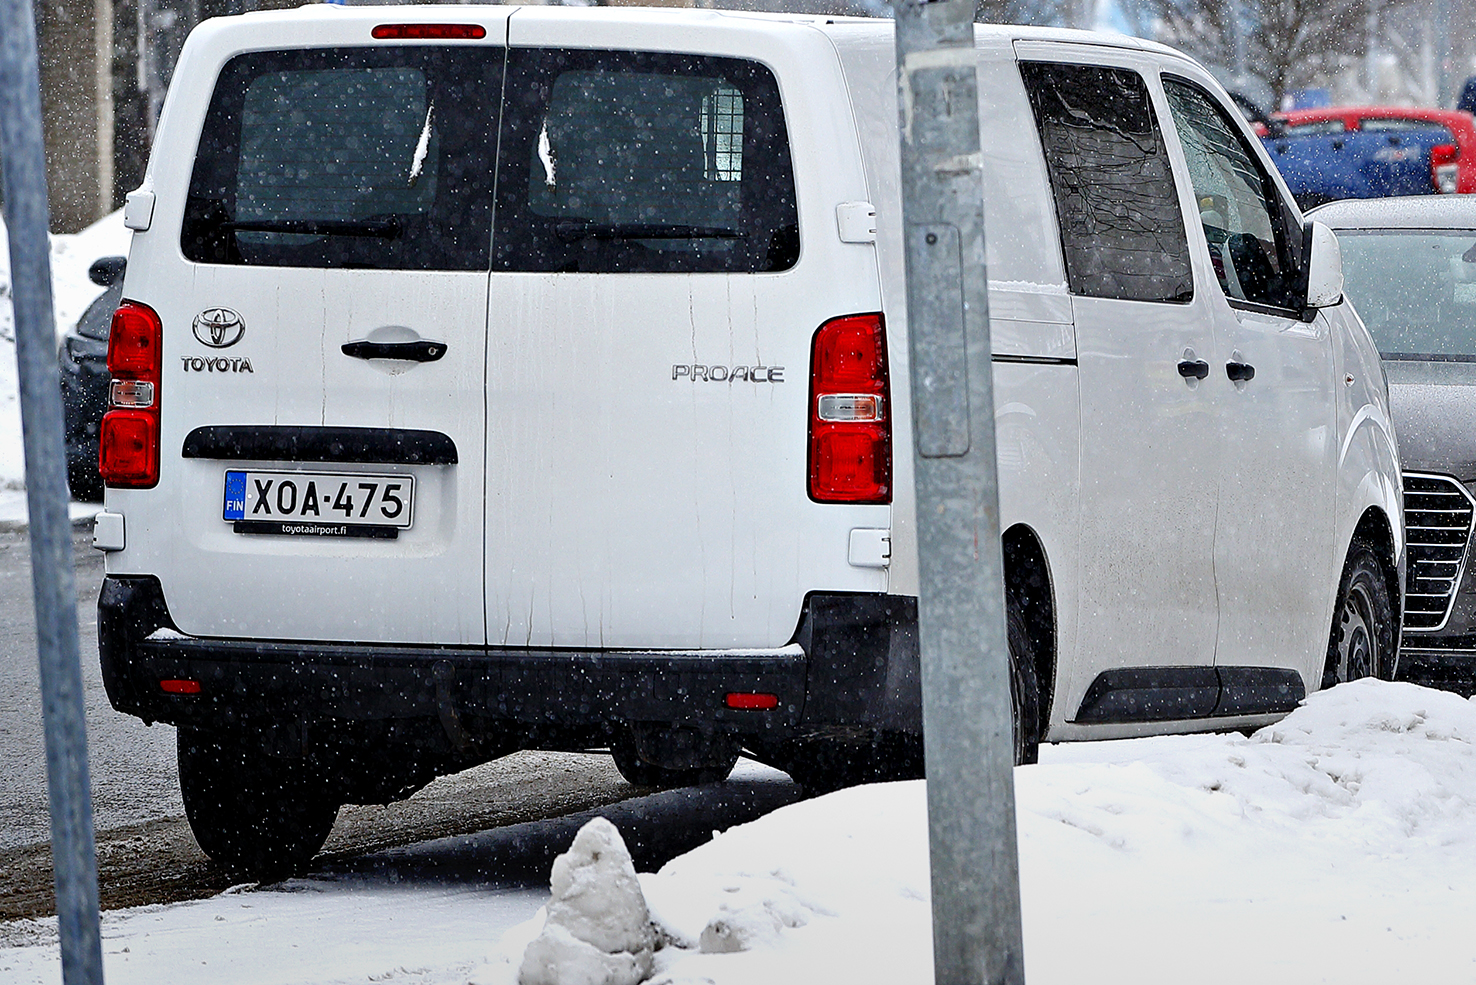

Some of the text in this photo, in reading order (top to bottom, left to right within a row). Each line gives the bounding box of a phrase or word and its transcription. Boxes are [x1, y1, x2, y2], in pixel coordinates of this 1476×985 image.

[181, 356, 254, 373] TOYOTA
[671, 365, 785, 383] PROACE
[226, 479, 403, 519] FIN XOA-475
[282, 524, 347, 535] toyotaairport.fi
